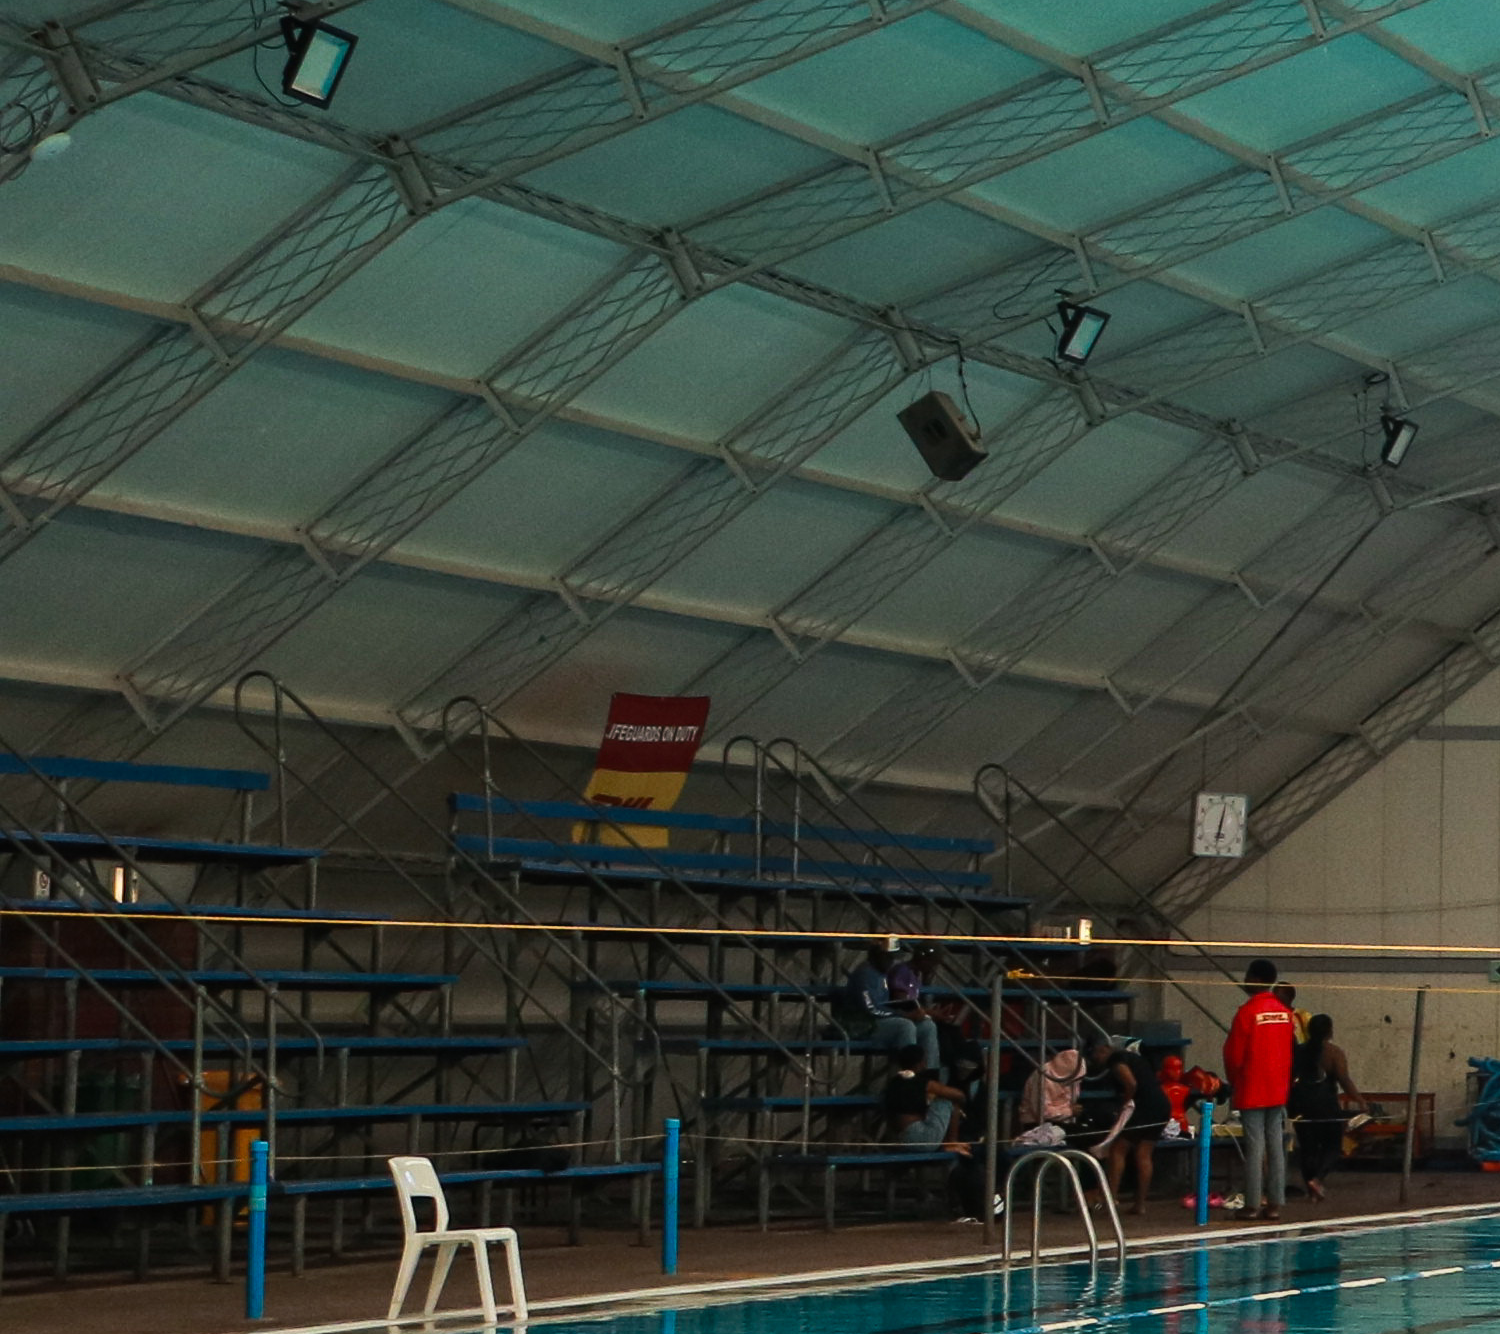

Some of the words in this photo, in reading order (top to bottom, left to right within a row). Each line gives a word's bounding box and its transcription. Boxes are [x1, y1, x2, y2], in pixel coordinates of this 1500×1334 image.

[605, 724, 660, 742] IFEGUARDS
[662, 726, 674, 742] ON
[675, 726, 698, 741] DUTY
